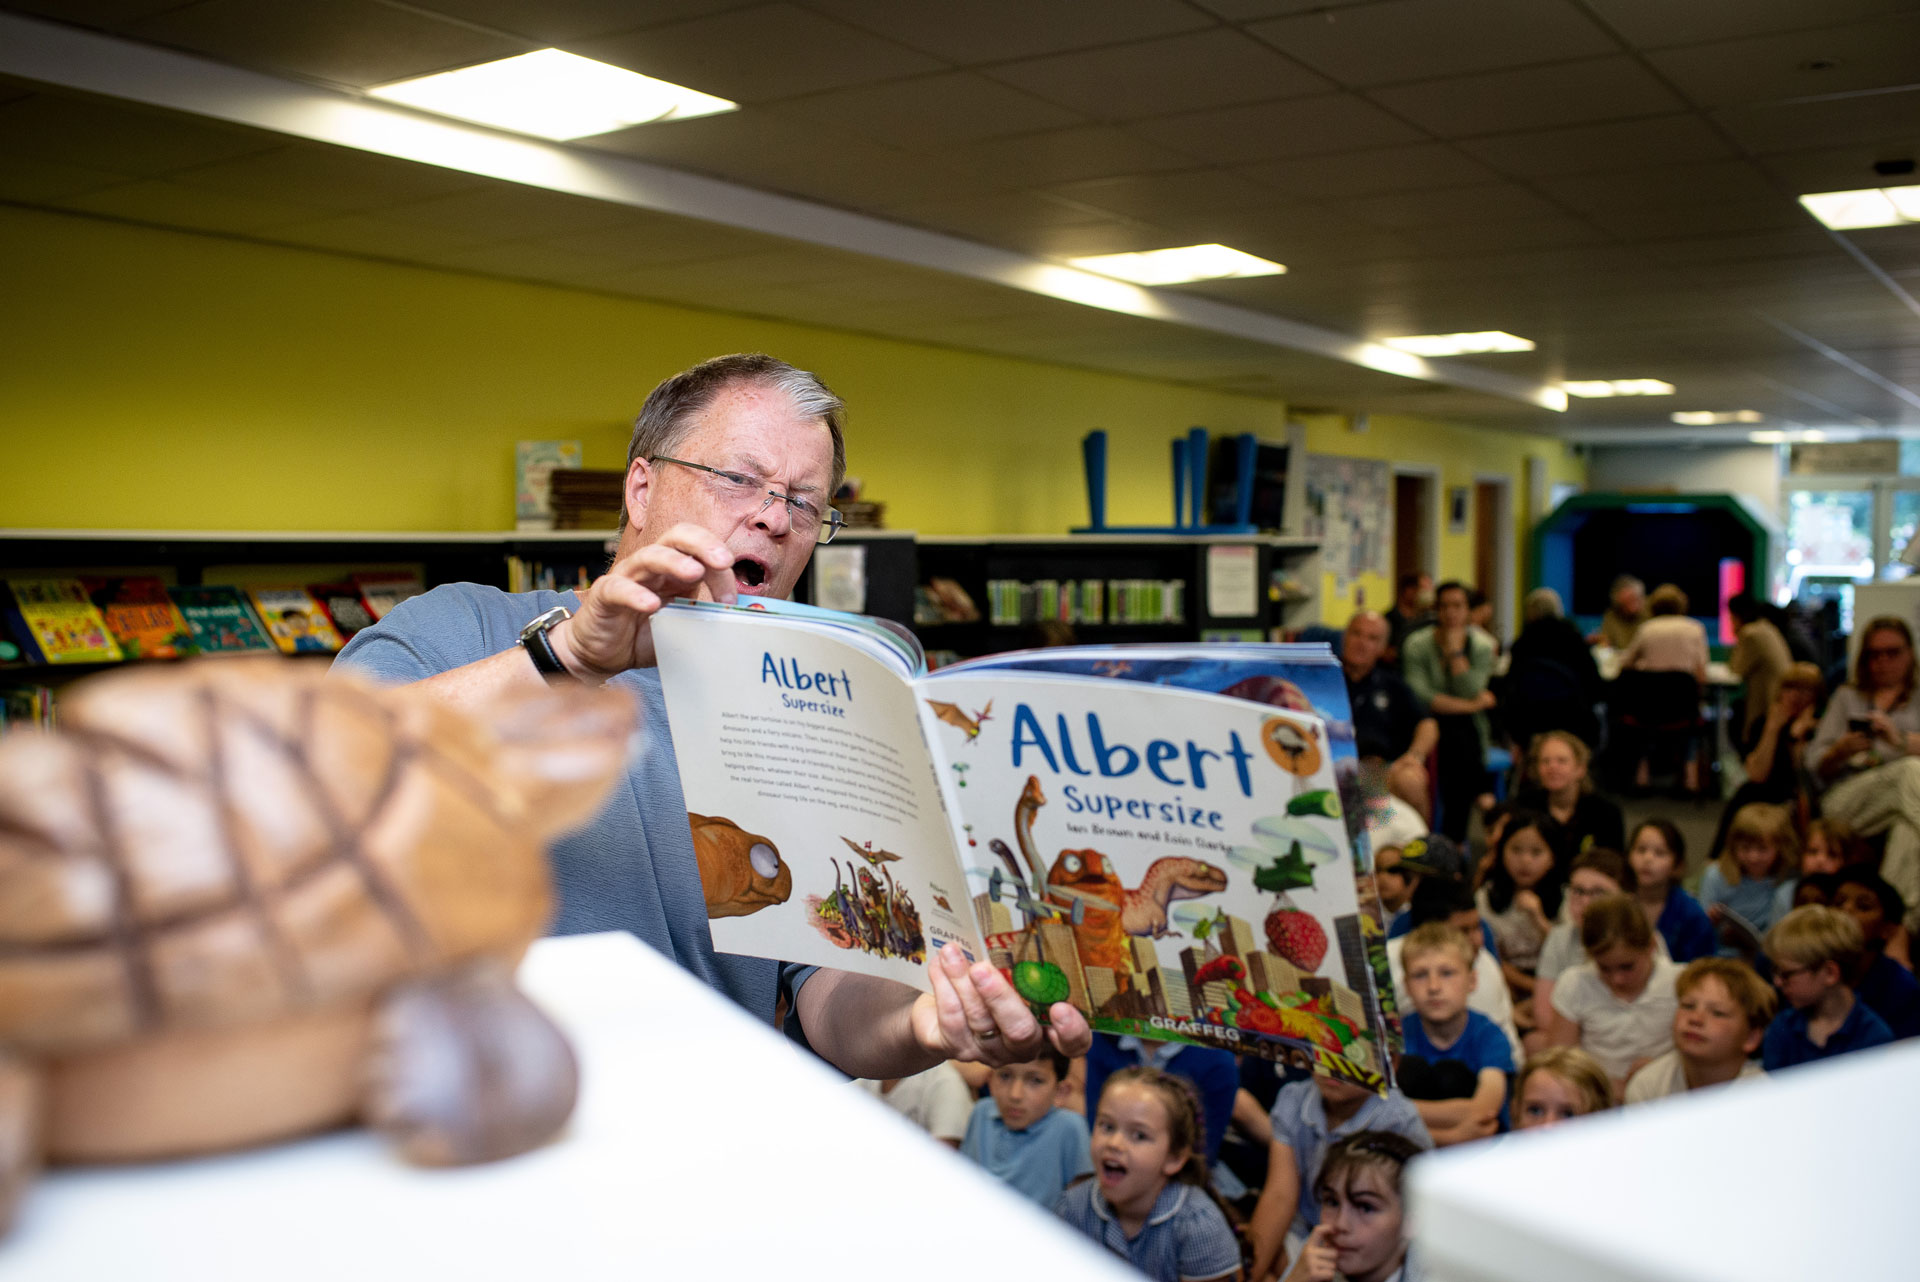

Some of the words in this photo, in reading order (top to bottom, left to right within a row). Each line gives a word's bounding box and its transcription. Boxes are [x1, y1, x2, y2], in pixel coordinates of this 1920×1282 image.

[762, 651, 853, 702] Albert
[781, 693, 846, 719] Supersize
[1010, 703, 1255, 798] Albert
[1063, 784, 1225, 831] Supersize
[1136, 830, 1162, 843] and
[1148, 1015, 1241, 1043] GRAFFEG
